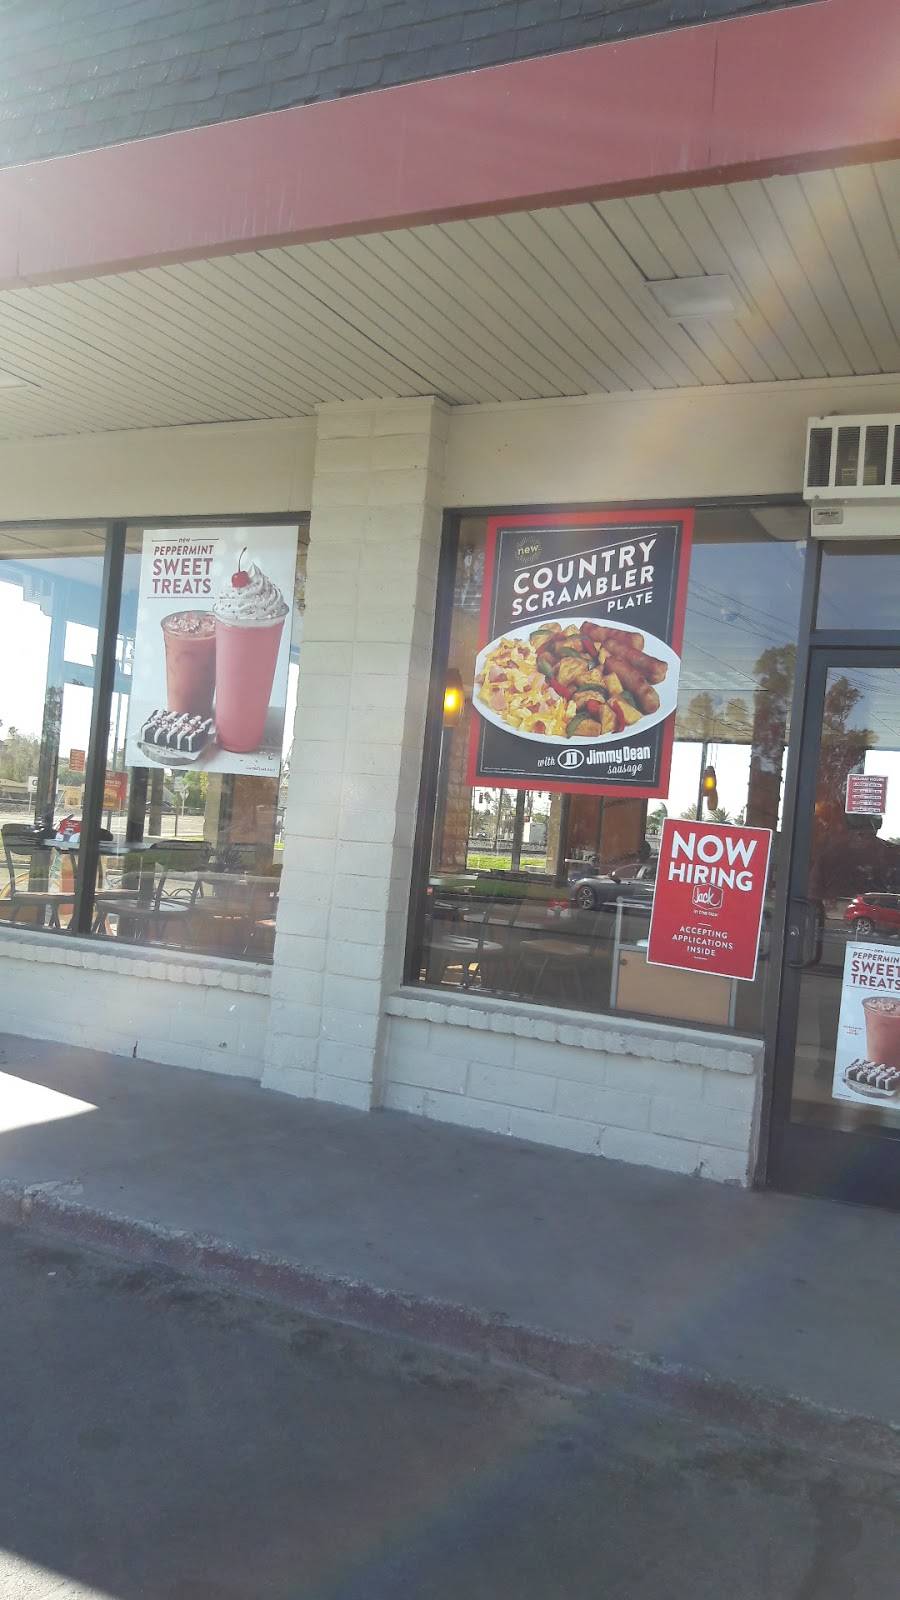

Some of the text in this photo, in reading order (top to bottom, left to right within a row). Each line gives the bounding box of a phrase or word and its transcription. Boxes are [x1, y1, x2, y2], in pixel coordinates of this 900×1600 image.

[154, 544, 215, 556] PEPPERMINT
[517, 544, 539, 555] new
[152, 557, 214, 576] SWEET
[513, 538, 657, 594] COUNTRY
[152, 578, 212, 594] TREATS
[511, 565, 655, 616] SCRAMBLER
[607, 591, 653, 613] PLATE
[537, 756, 556, 768] with
[607, 763, 643, 777] sausage
[671, 830, 758, 868] NOW
[668, 861, 753, 891] HIRING
[693, 887, 721, 907] Jack
[679, 926, 728, 940] ACCEPTING
[672, 934, 733, 950] APPLICATIONS
[687, 945, 716, 957] INSIDE
[853, 951, 900, 964] PEPPERMIN
